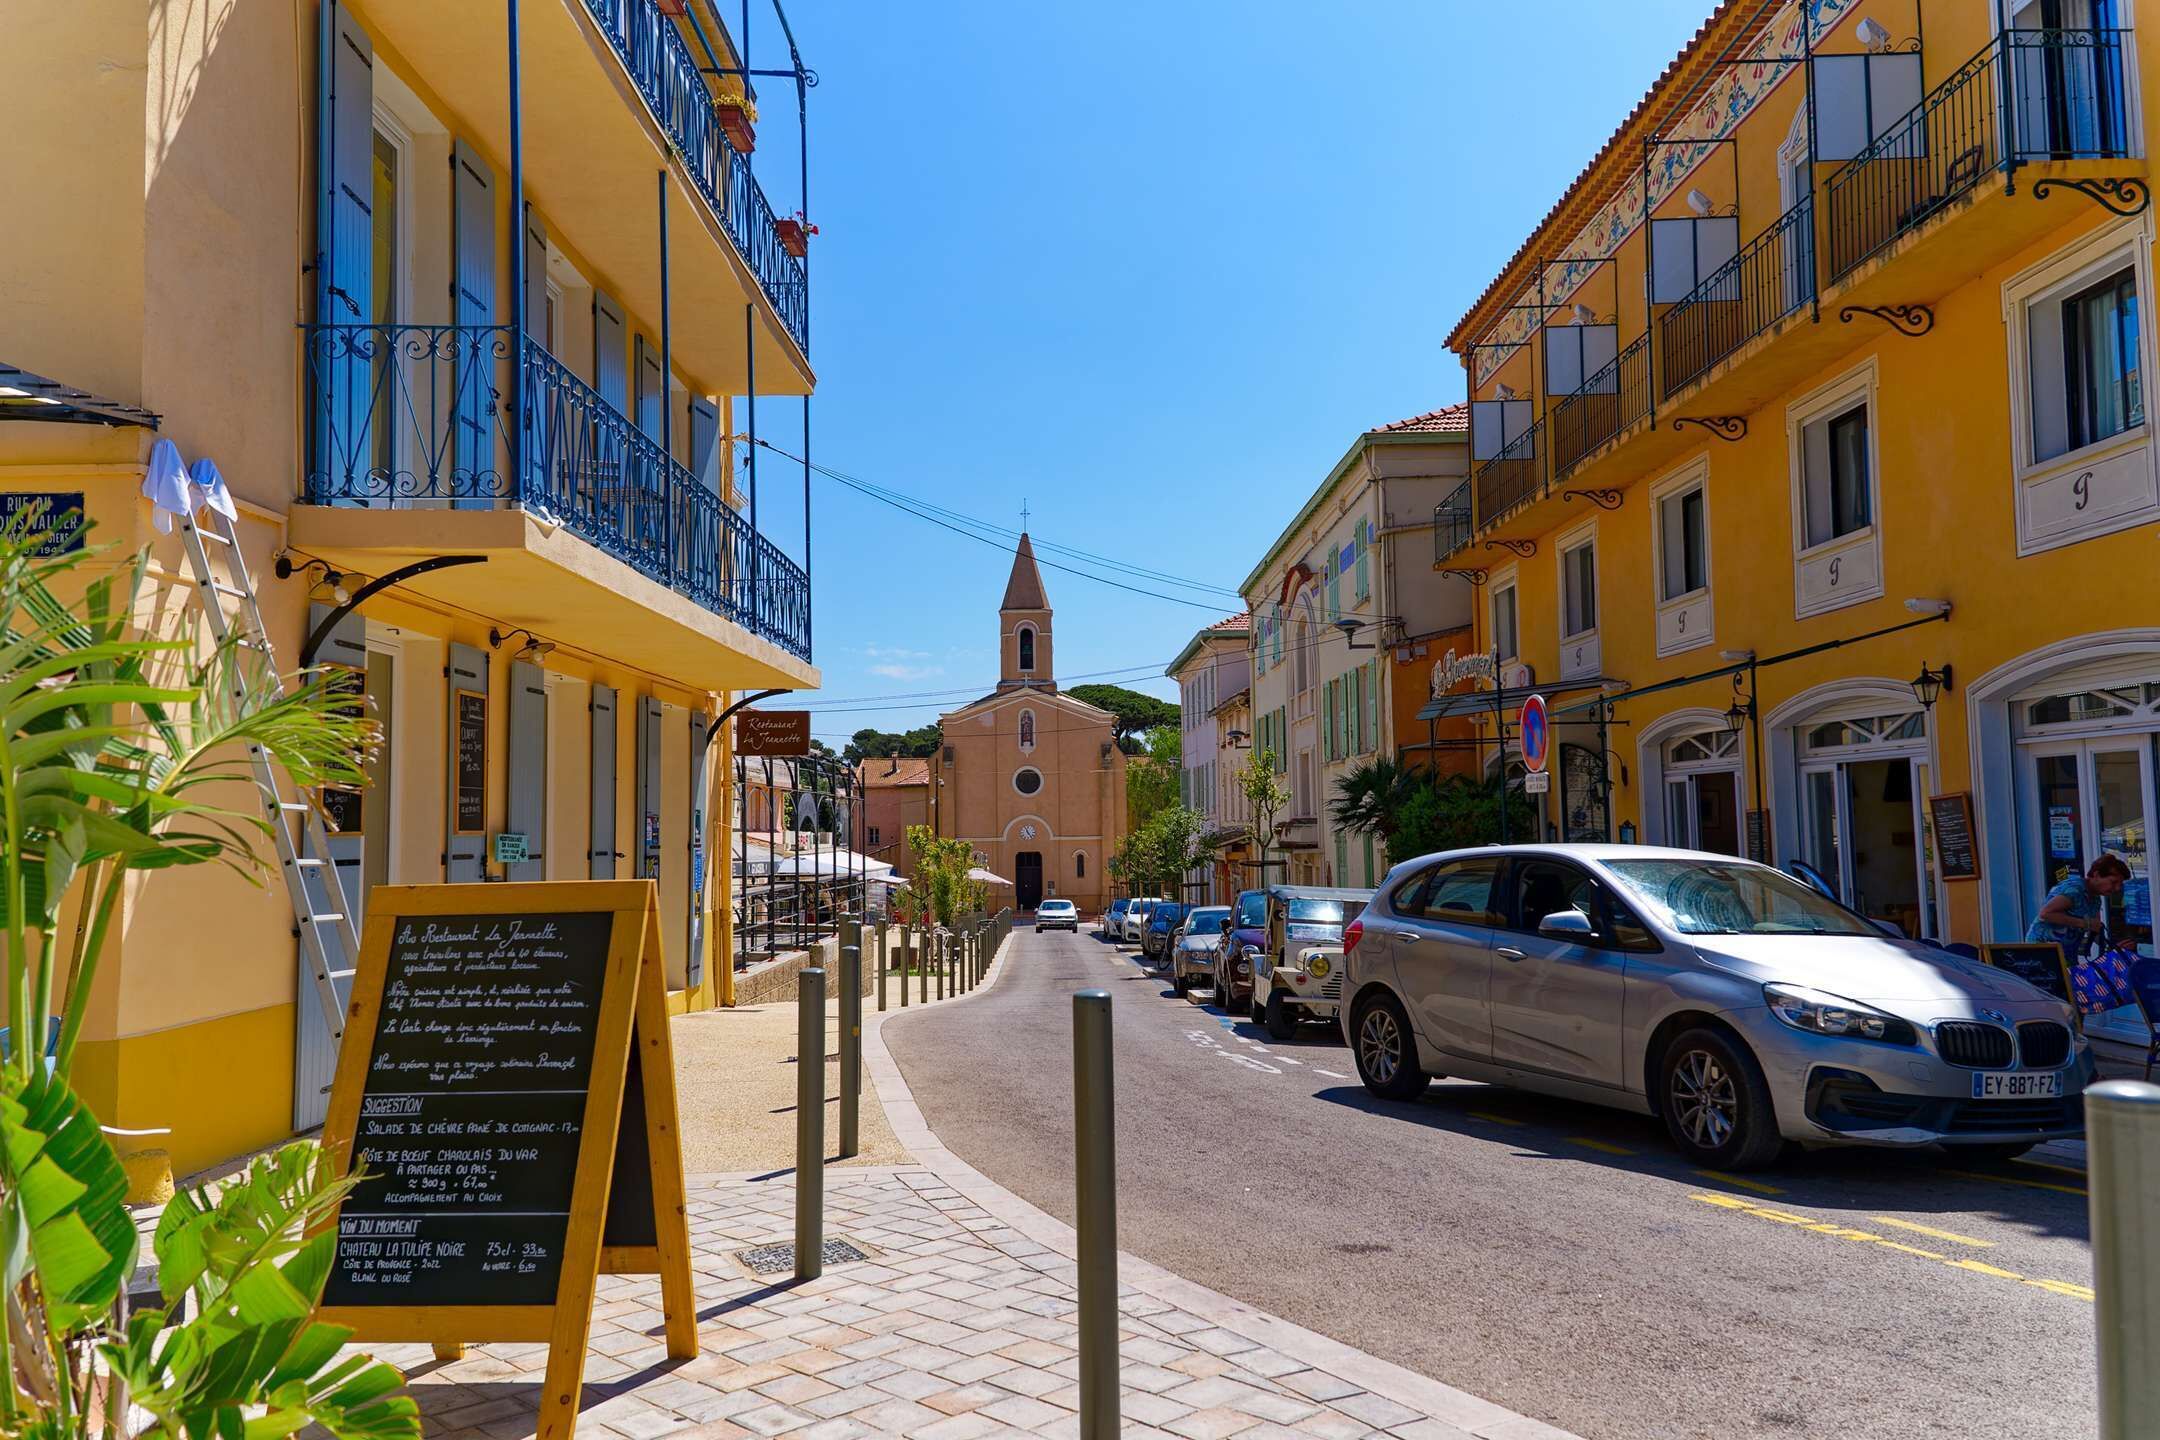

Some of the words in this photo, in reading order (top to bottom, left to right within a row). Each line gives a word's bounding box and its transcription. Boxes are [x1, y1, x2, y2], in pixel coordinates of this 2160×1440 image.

[748, 718, 797, 730] Restaurant
[751, 732, 801, 751] Jeannette
[421, 923, 480, 943] Restaurant
[484, 924, 502, 941] La
[365, 1120, 405, 1136] SALADE
[409, 1123, 424, 1135] DE
[385, 1150, 400, 1162] DE
[437, 1147, 493, 1162] CHAROLAIS
[497, 1148, 514, 1161] DU
[514, 1147, 540, 1161] VAR
[406, 1163, 452, 1176] PARTAGER
[384, 1192, 459, 1203] ACCOMPAGNEMENT
[462, 1193, 475, 1203] AU
[478, 1192, 503, 1202] CHOIX
[358, 1219, 376, 1234] DU
[375, 1218, 423, 1234] MOMENT
[340, 1241, 383, 1257] CHATEAU
[385, 1241, 400, 1257] LA
[435, 1241, 466, 1257] NOIRE
[363, 1259, 375, 1269] DE
[351, 1272, 377, 1283] BLANC
